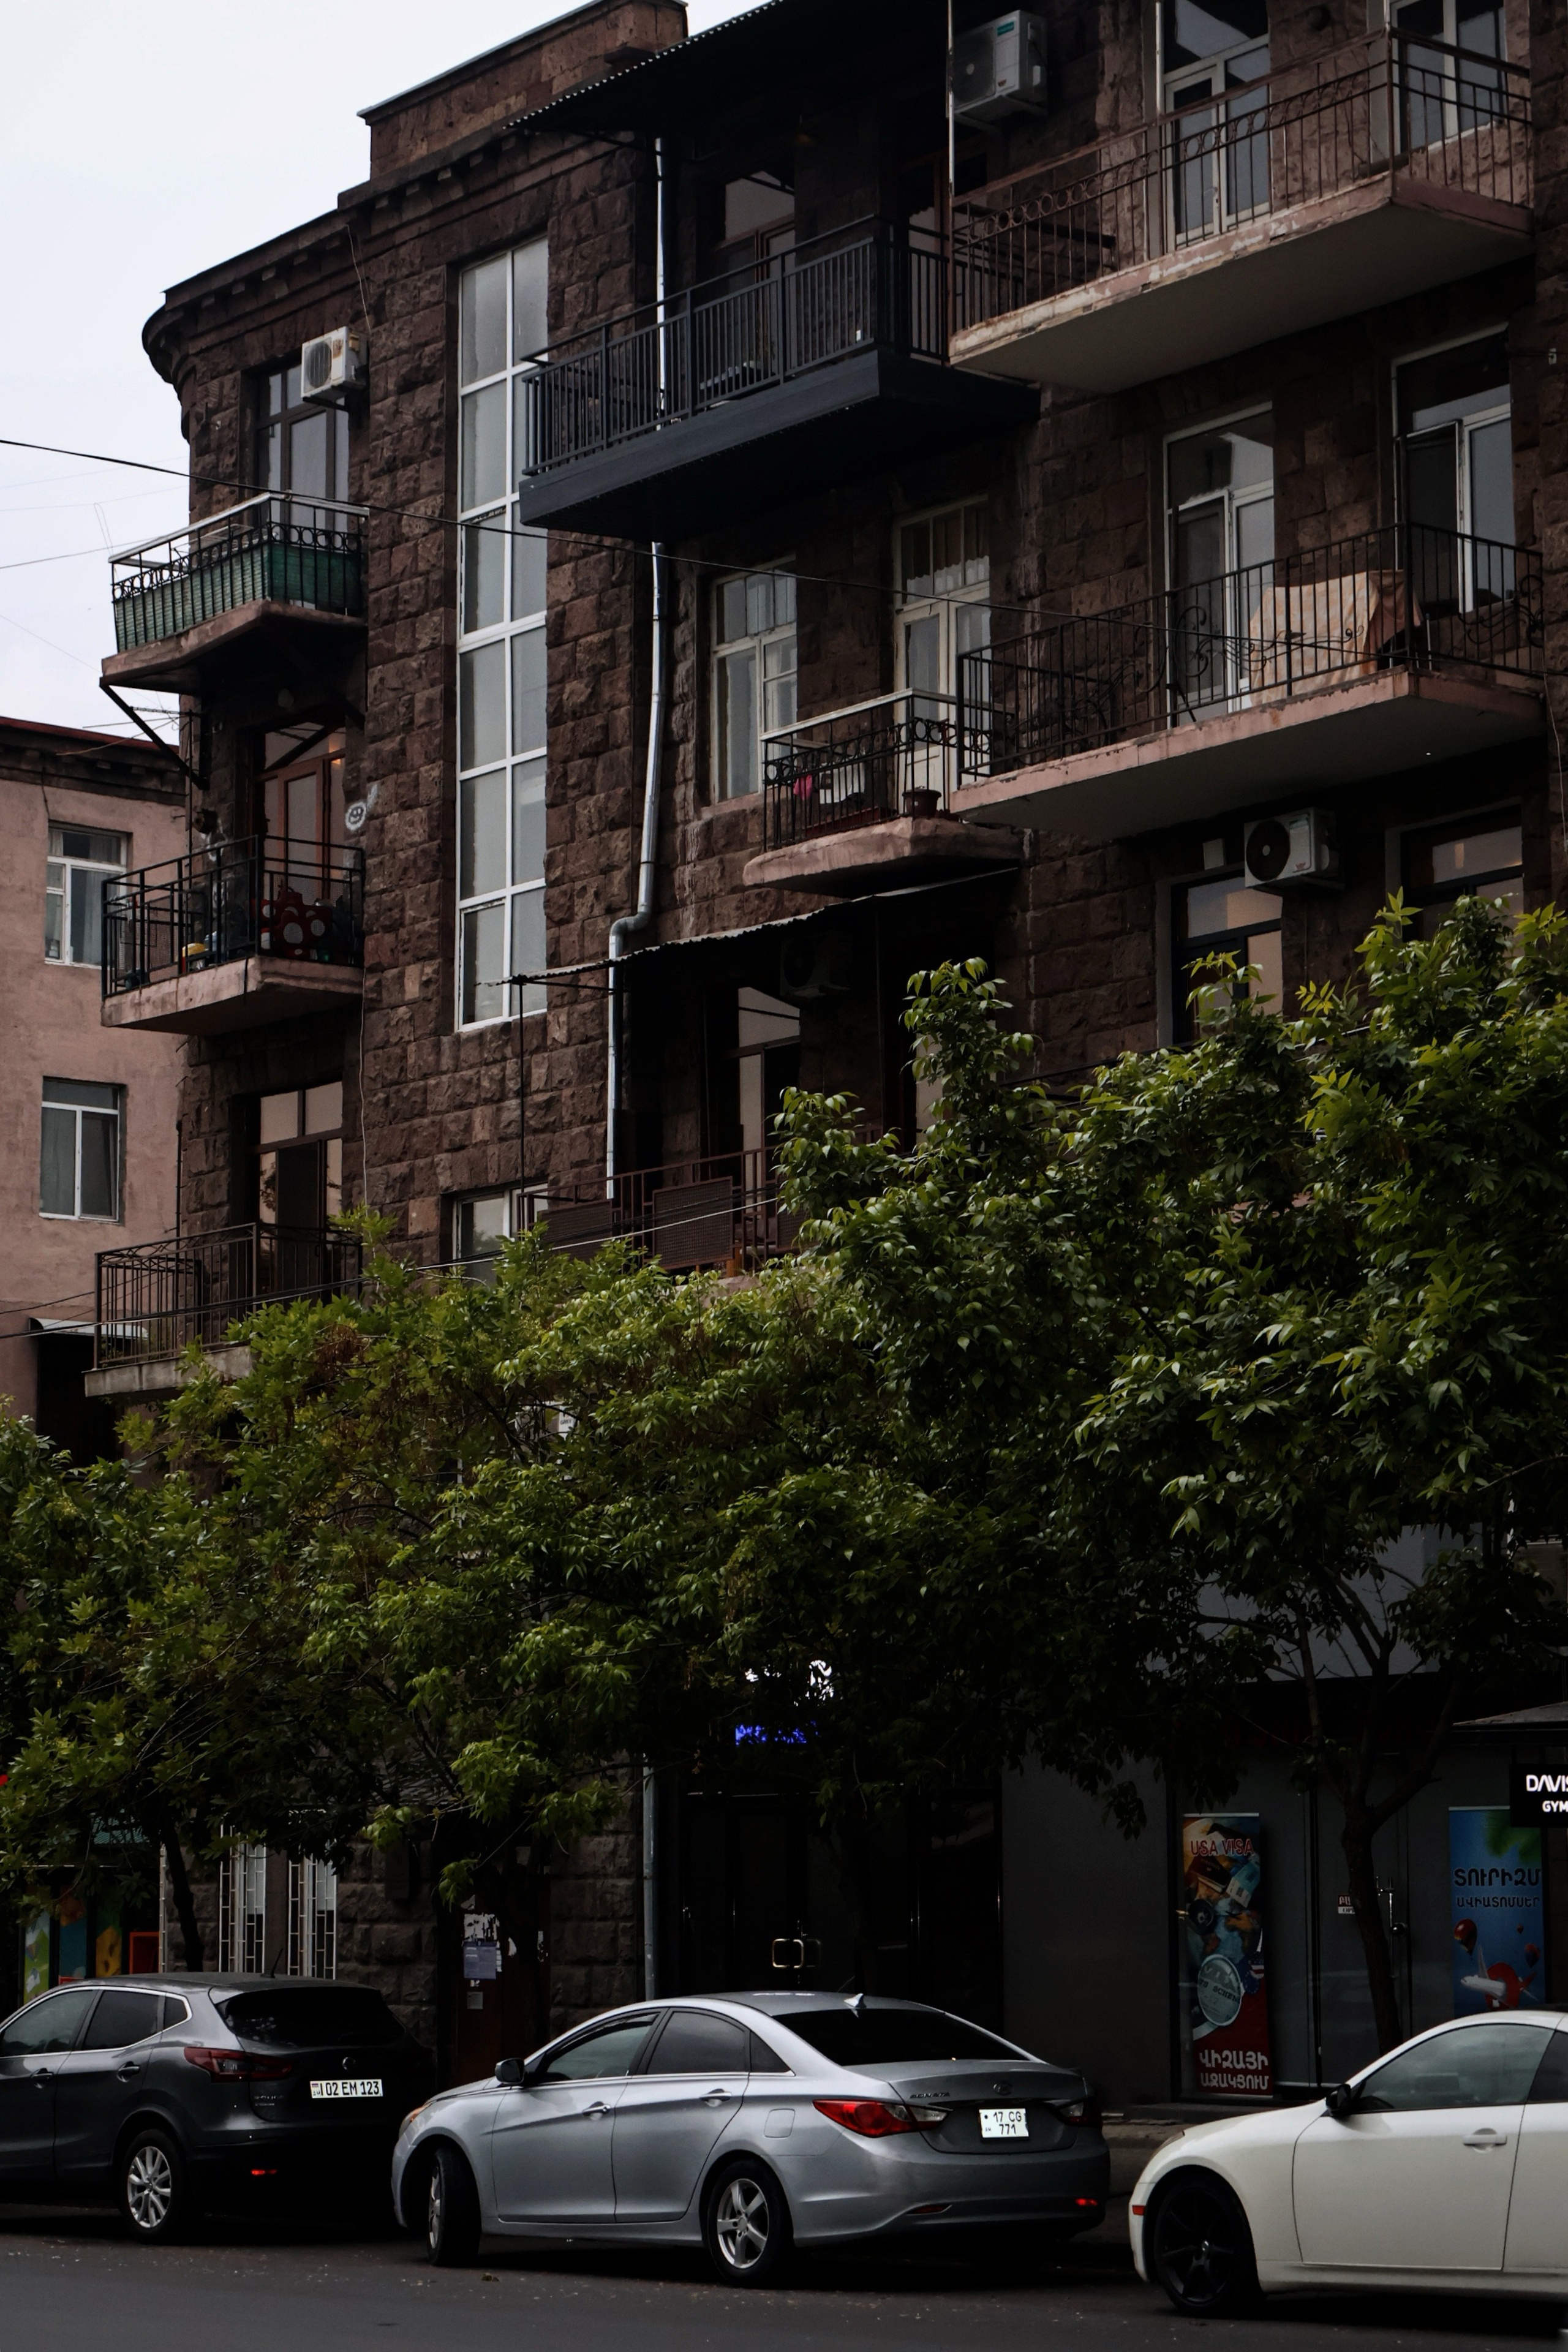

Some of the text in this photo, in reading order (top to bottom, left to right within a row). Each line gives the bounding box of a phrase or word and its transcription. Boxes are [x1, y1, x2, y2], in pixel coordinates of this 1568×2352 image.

[1526, 1774, 1568, 1793] DAVI
[1542, 1800, 1568, 1813] GYM
[1190, 1838, 1256, 1857] USA VISA
[1453, 1868, 1542, 1887] ՏՈՒՐԻԶՄ
[1457, 1896, 1540, 1909] ԱՎԻԱՏՈՄՍԵՐ
[1199, 2049, 1269, 2071] ՎԻԶԱՅԻ
[325, 2082, 339, 2097] 02
[341, 2081, 358, 2096] EM
[360, 2081, 380, 2095] 123
[1200, 2071, 1270, 2091] ԱՋԱԿՑՈՒՄ
[993, 2111, 1022, 2123] 17 CG
[998, 2124, 1017, 2135] 771
